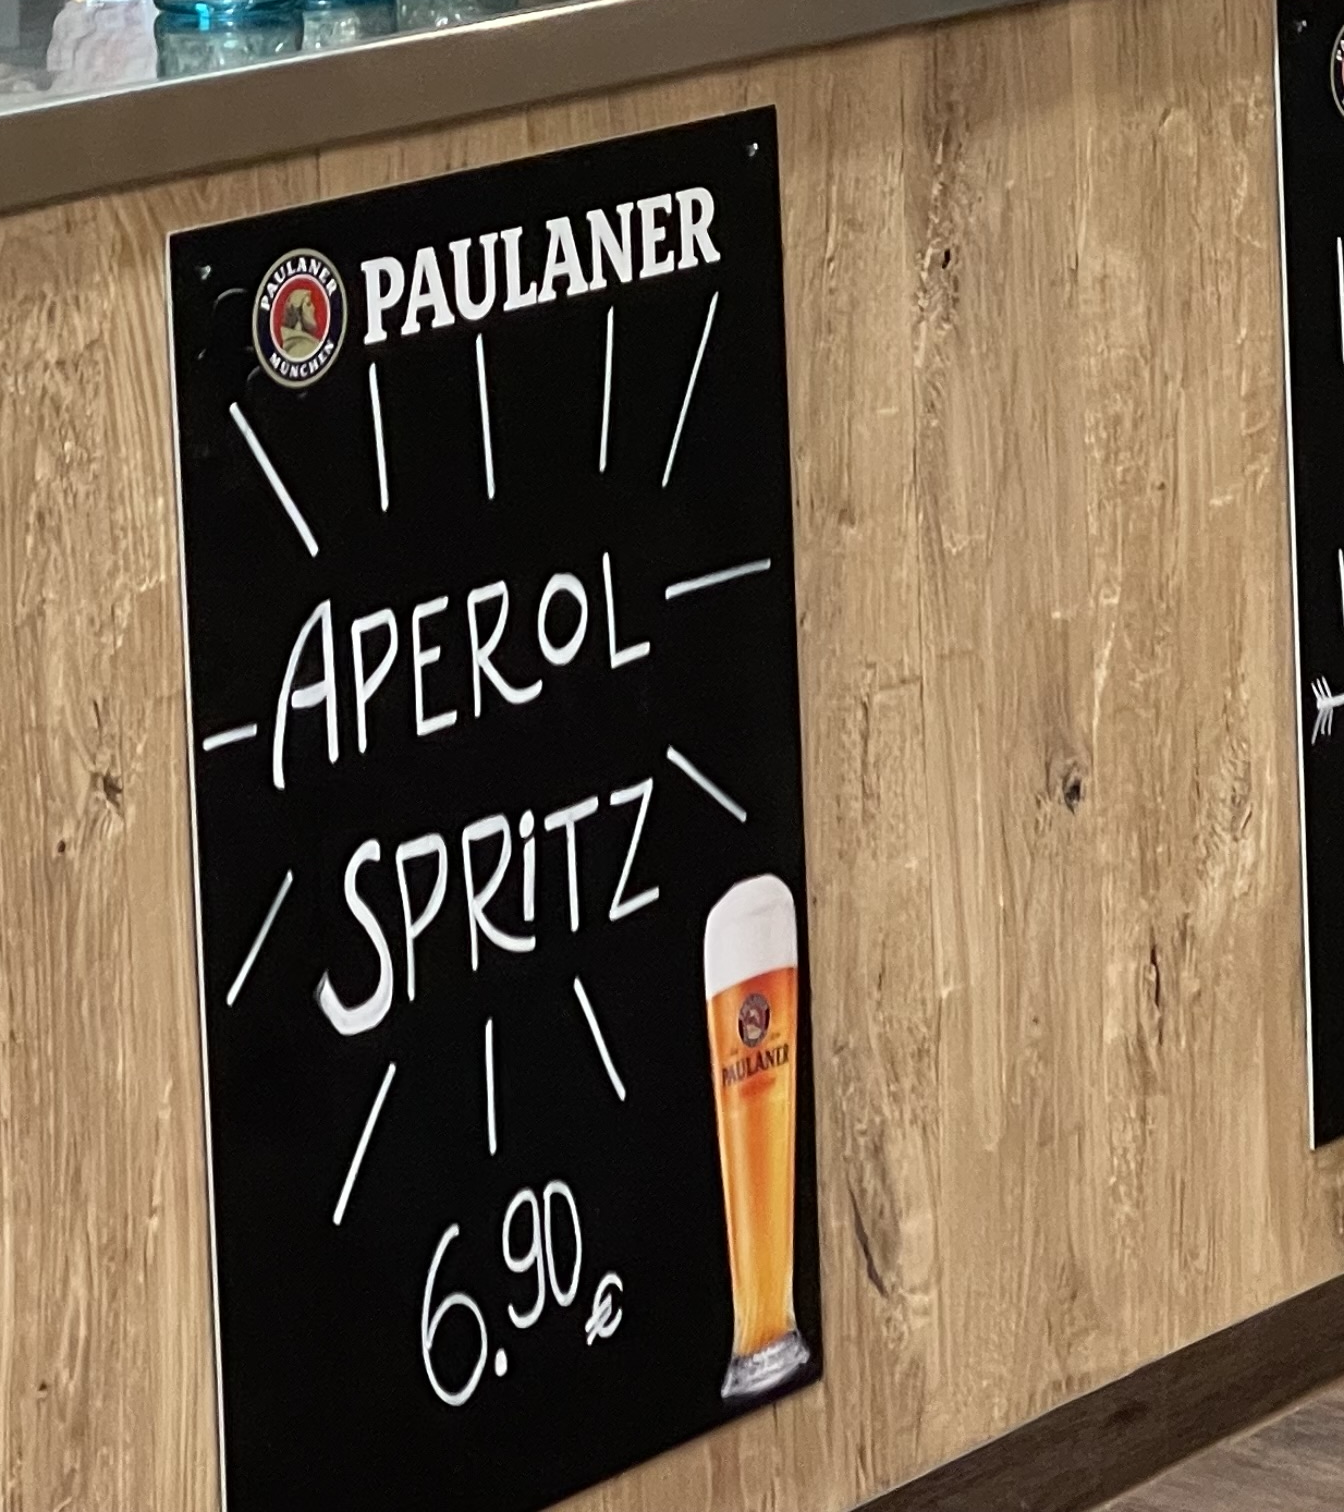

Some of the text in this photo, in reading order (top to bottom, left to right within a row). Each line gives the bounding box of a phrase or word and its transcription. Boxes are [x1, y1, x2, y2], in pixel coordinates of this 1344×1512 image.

[260, 256, 338, 311] PAULANER
[361, 187, 720, 345] PAULANER
[272, 552, 651, 790] APEROL
[722, 1043, 789, 1087] PAULANER
